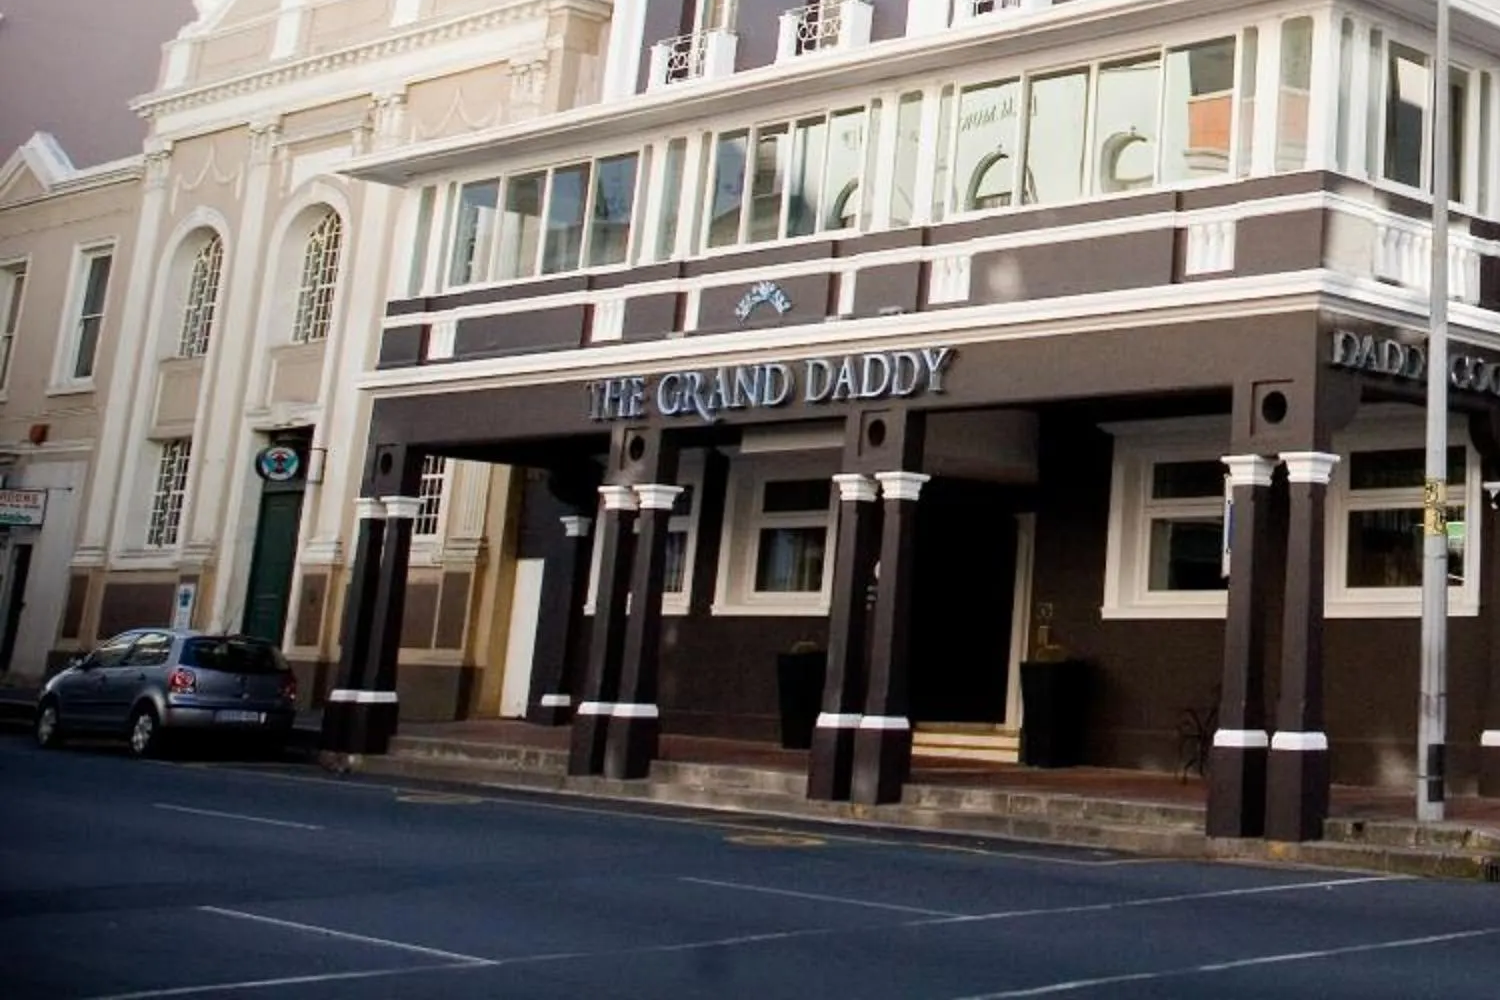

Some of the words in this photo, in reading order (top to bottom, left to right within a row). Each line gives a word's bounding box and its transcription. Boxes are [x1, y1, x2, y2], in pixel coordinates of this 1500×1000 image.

[588, 376, 645, 419] THE
[656, 361, 793, 421] GRAND
[803, 348, 952, 402] DADDY
[1332, 328, 1434, 379] DADD
